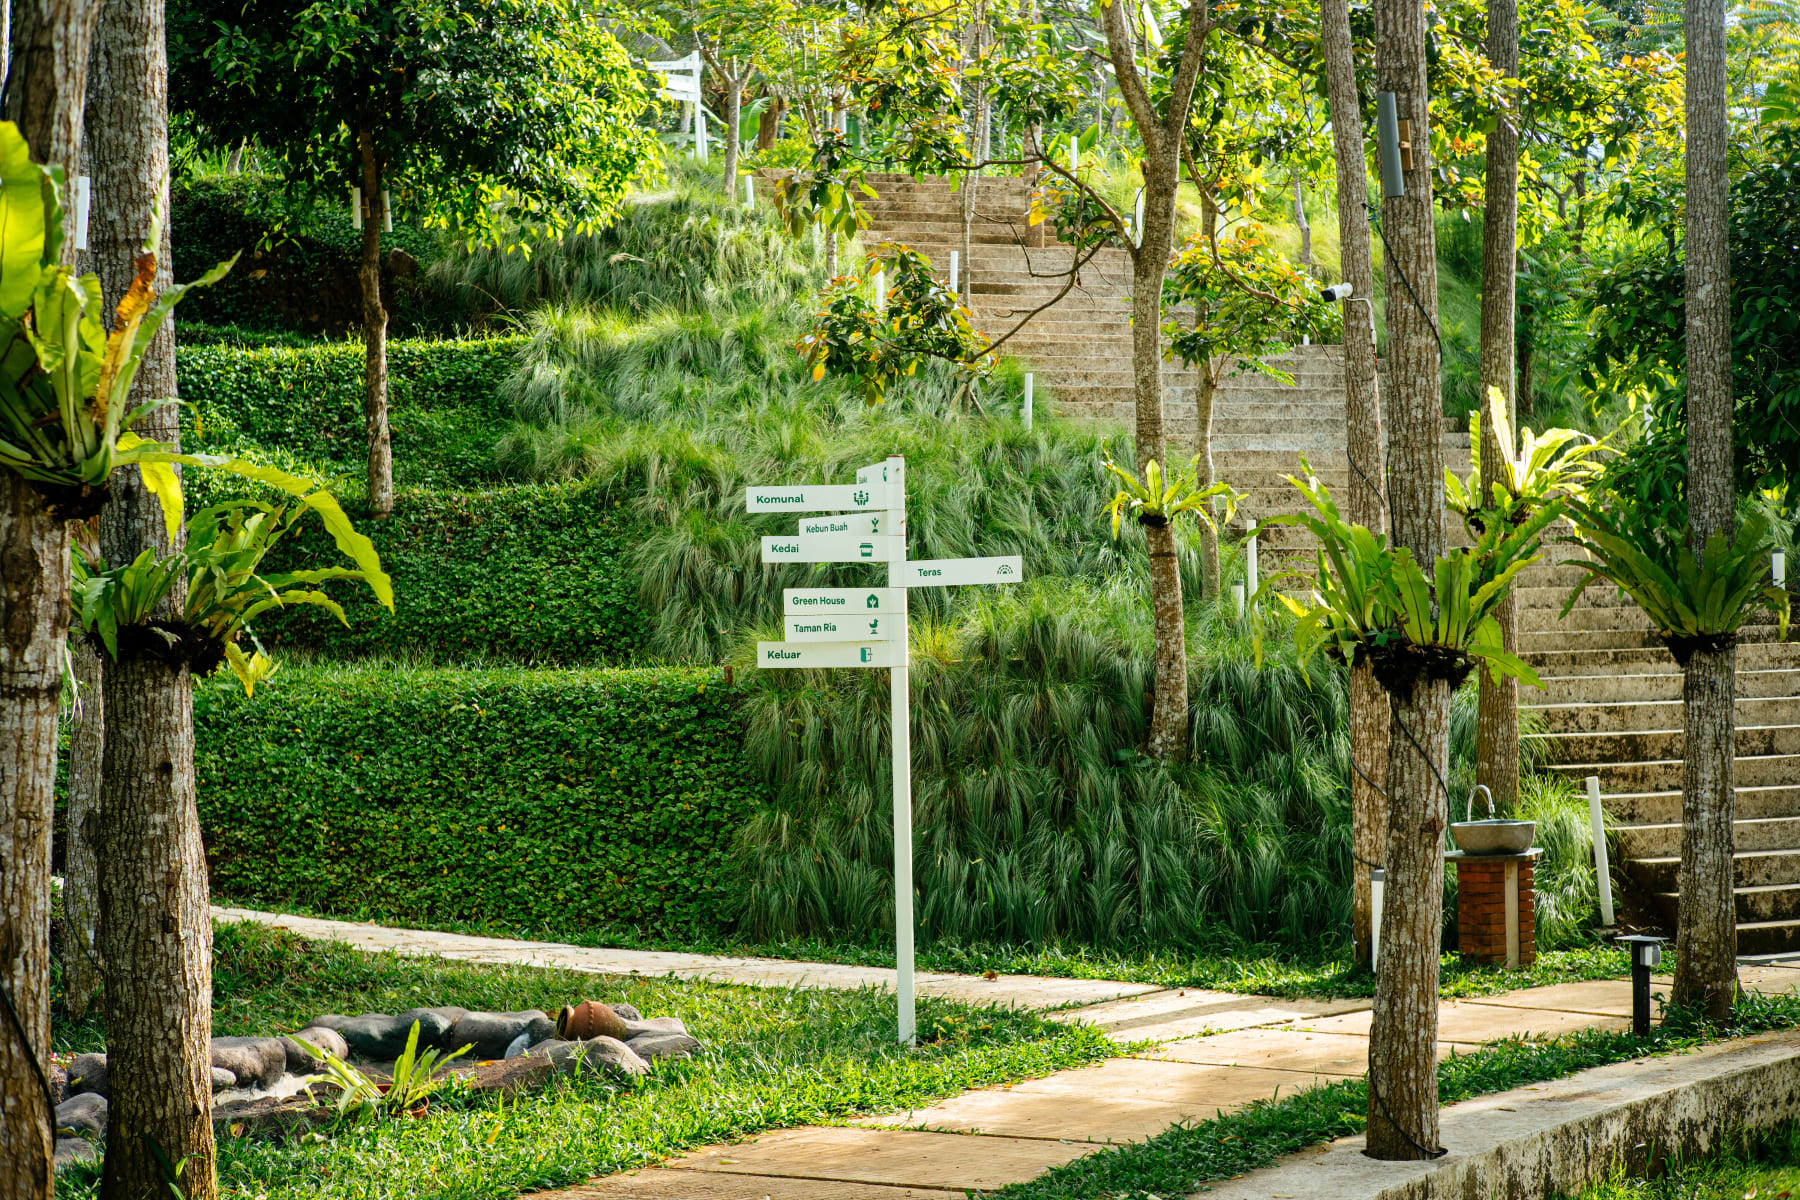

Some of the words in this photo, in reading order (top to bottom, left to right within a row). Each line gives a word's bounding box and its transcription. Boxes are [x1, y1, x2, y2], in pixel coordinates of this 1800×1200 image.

[756, 493, 805, 504] Komunal
[806, 523, 828, 534] Kebun
[830, 522, 848, 532] Buah
[771, 544, 799, 553] Kedai
[918, 568, 942, 577] Teras
[792, 596, 818, 606] Green
[820, 596, 846, 605] House
[794, 624, 821, 633] Taman
[823, 622, 837, 632] Ria
[767, 649, 801, 660] Keluar
